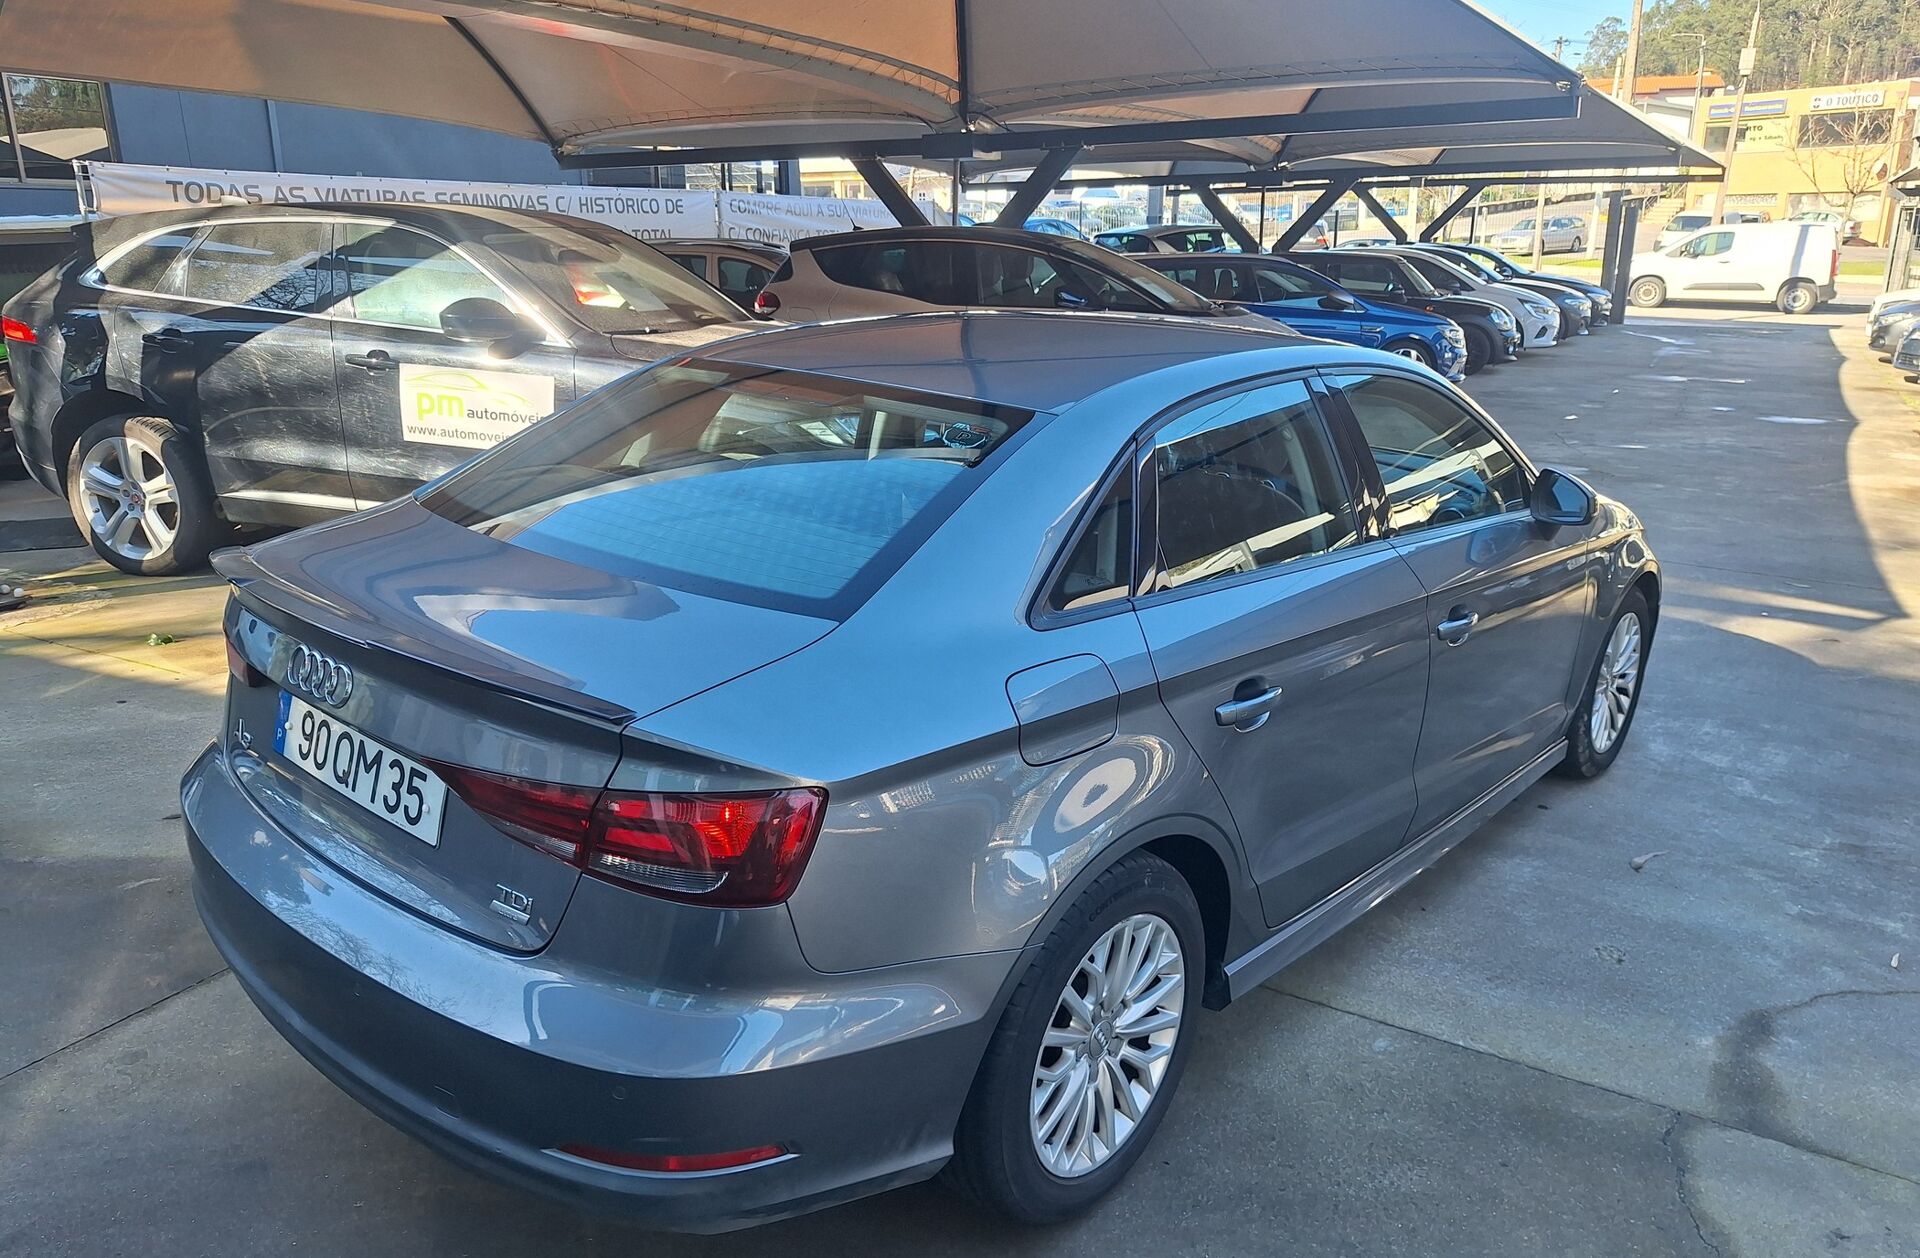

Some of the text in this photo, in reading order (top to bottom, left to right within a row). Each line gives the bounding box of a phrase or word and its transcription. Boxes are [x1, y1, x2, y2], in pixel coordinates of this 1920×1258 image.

[165, 179, 263, 204] TODAS
[273, 185, 307, 203] AS
[578, 192, 660, 215] HISTÓRICO
[665, 199, 684, 214] DE
[729, 198, 782, 216] COMPRE
[785, 202, 812, 217] AQUI
[816, 204, 825, 218] A
[828, 203, 850, 218] SUA
[416, 392, 464, 421] pm
